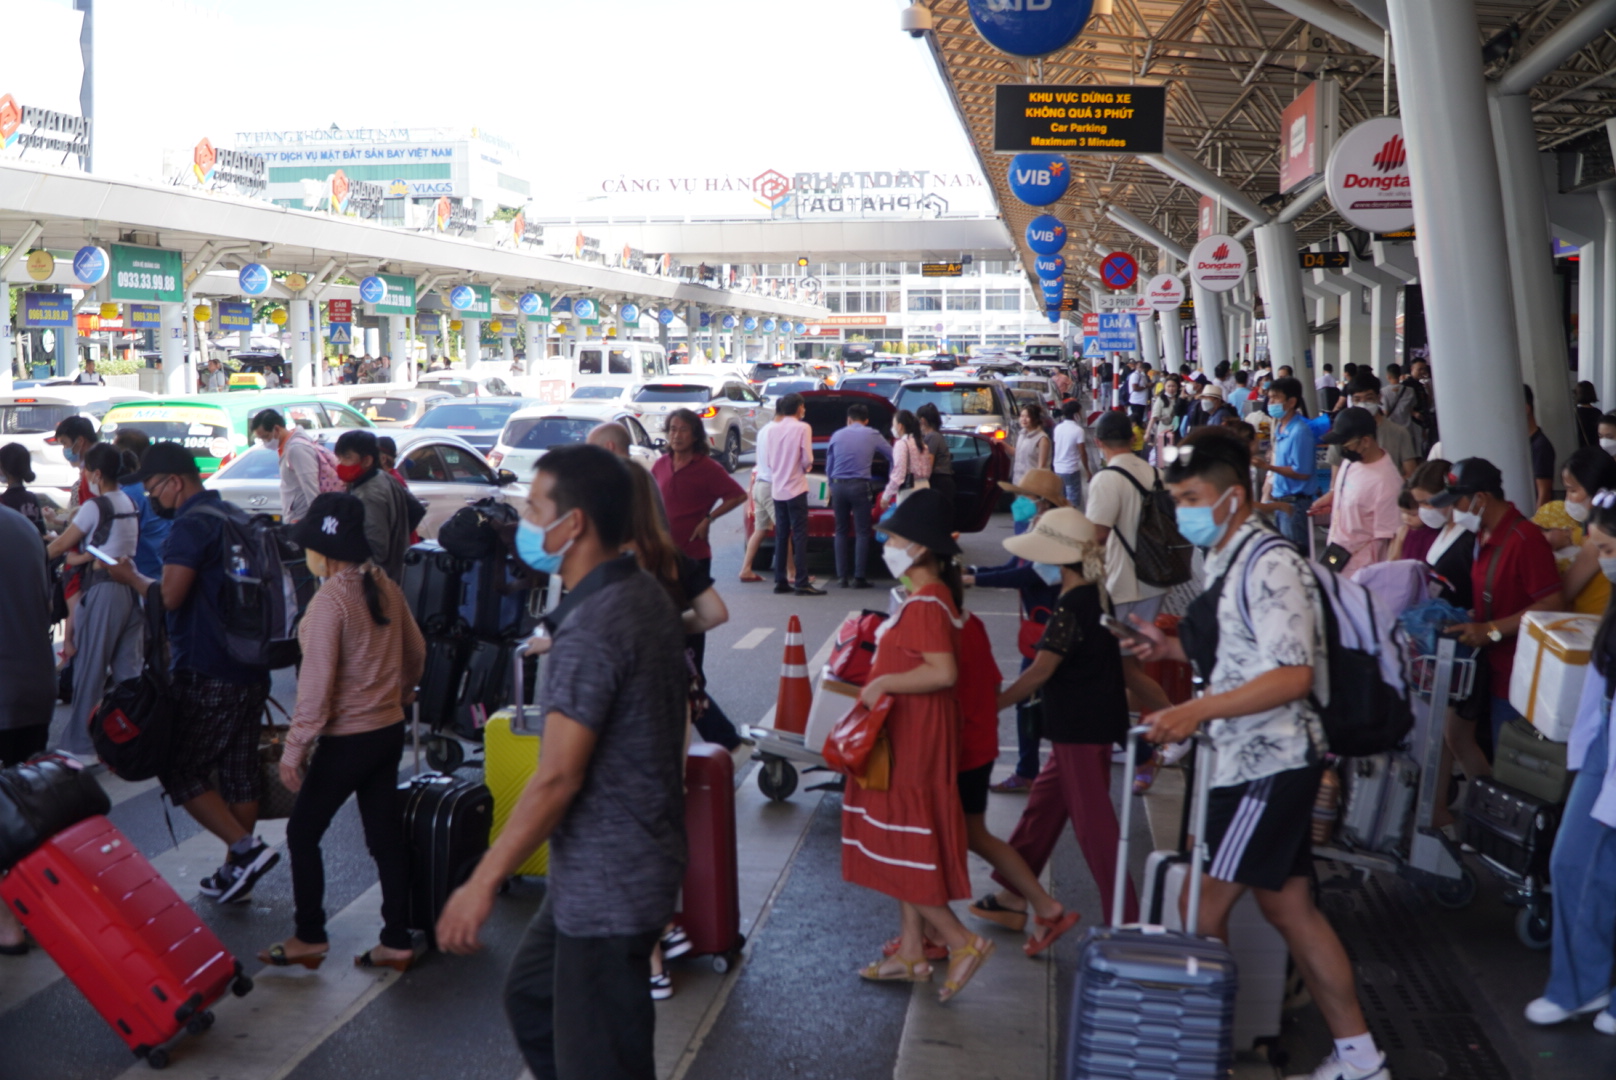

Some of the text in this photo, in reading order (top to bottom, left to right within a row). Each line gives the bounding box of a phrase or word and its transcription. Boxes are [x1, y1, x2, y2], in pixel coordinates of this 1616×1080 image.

[1029, 91, 1131, 104] KHU VỰC DỪNG XE
[1025, 106, 1135, 119] KHÔNG QUÁ 3 PHÚT
[1050, 122, 1107, 134] Car Parking
[378, 128, 409, 141] NAM
[1031, 137, 1126, 147] Maximum 3 Minutes
[265, 151, 277, 160] TY
[280, 151, 302, 163] DỊCH
[306, 151, 317, 162] VỤ
[387, 149, 405, 158] BAY
[408, 147, 428, 160] VIỆT
[431, 148, 452, 157] NAM
[1016, 169, 1051, 186] VIB
[1343, 174, 1410, 191] Dongta
[413, 182, 453, 193] VIAGS
[602, 174, 659, 192] CẢNG
[668, 178, 697, 195] VỤ
[933, 175, 983, 187] NAM
[1031, 230, 1054, 242] VIB
[1038, 261, 1056, 271] VIB
[1304, 254, 1324, 266] D4
[1198, 262, 1241, 271] Dongtam
[1103, 316, 1131, 328] LÀN A
